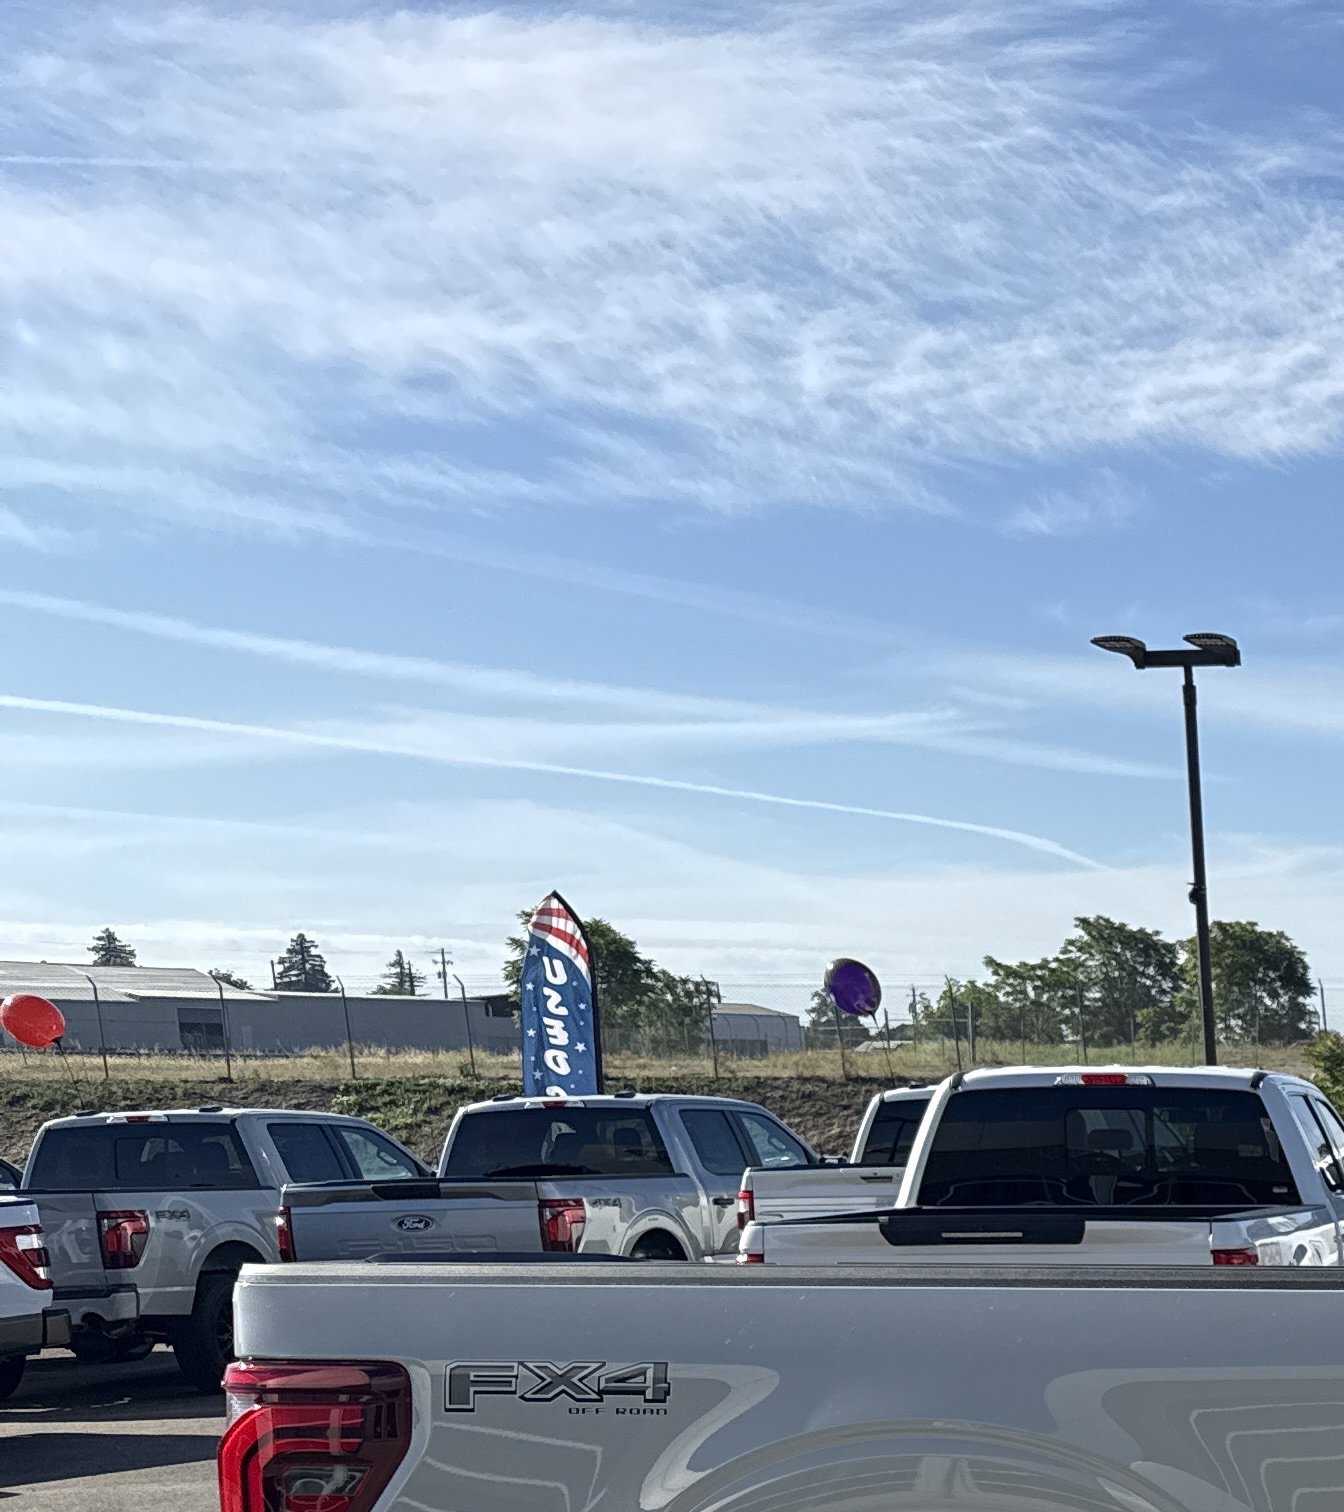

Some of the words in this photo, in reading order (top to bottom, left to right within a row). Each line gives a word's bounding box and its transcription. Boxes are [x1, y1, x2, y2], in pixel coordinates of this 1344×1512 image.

[444, 1360, 670, 1413] FX4
[568, 1406, 606, 1415] OFF
[615, 1406, 668, 1416] ROAD
